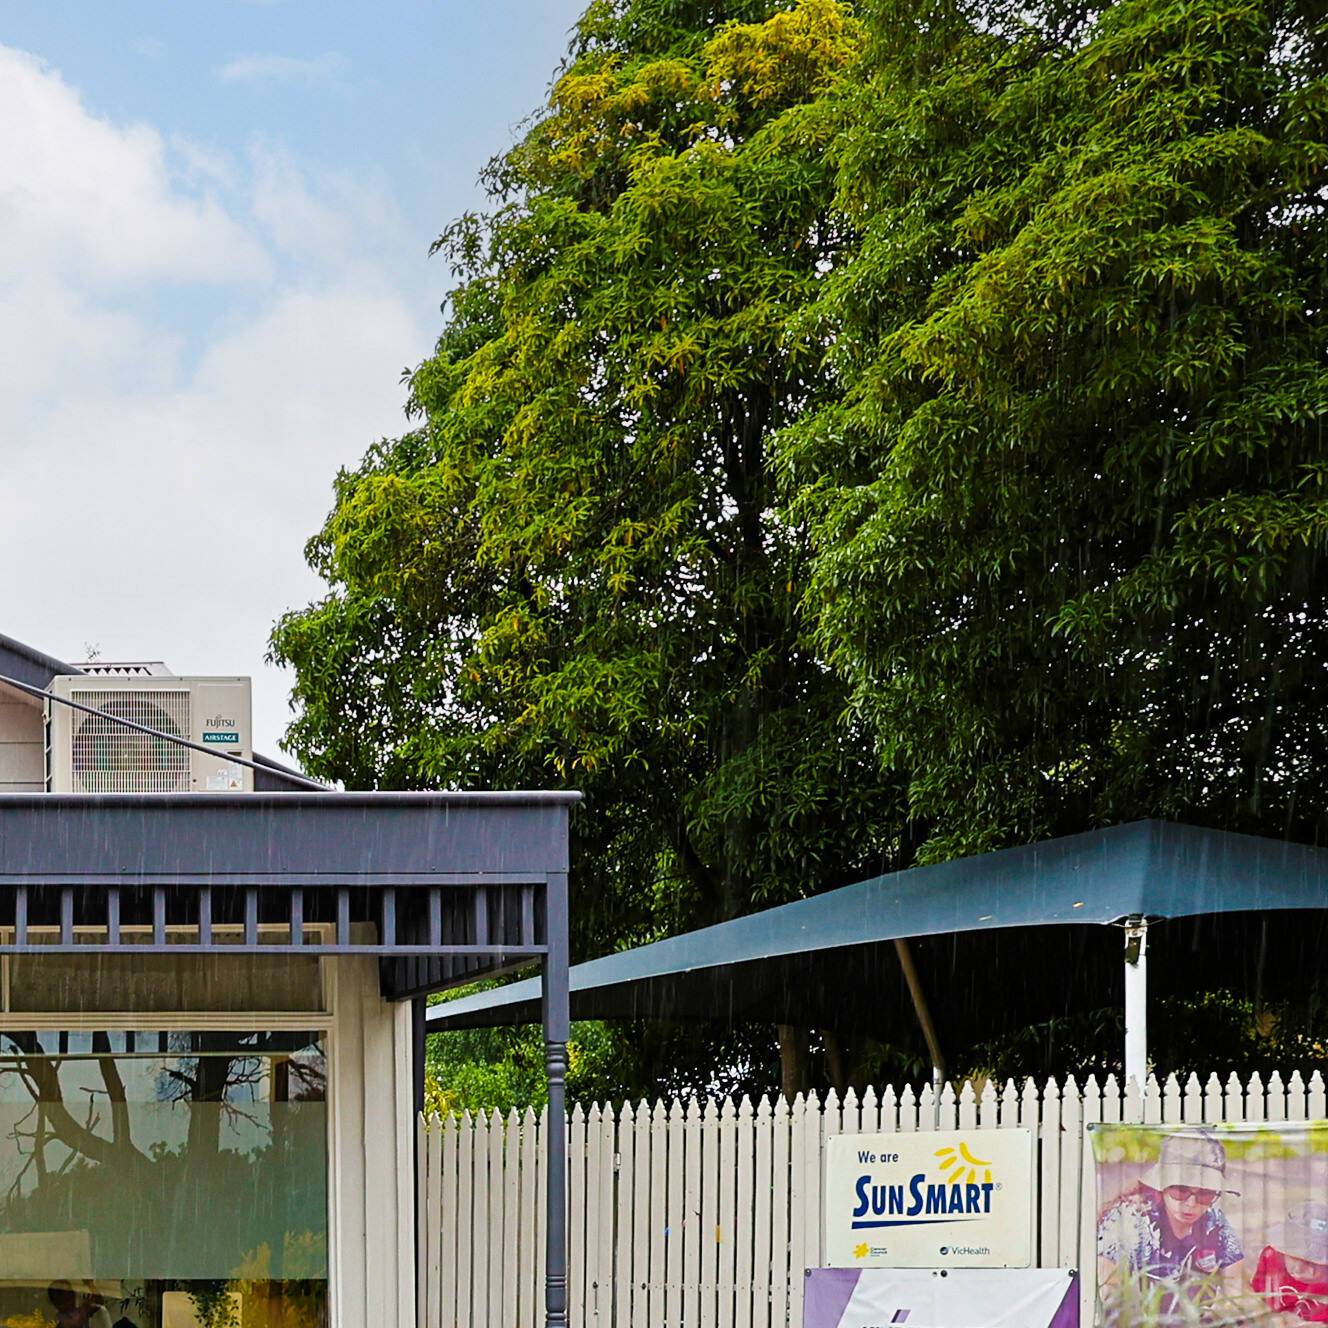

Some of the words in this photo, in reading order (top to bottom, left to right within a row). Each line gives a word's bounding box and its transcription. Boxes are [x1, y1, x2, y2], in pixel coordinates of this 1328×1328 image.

[206, 718, 235, 728] FUJITSU
[858, 1151, 877, 1163] We
[880, 1152, 899, 1163] are
[951, 1247, 990, 1255] VicHealth
